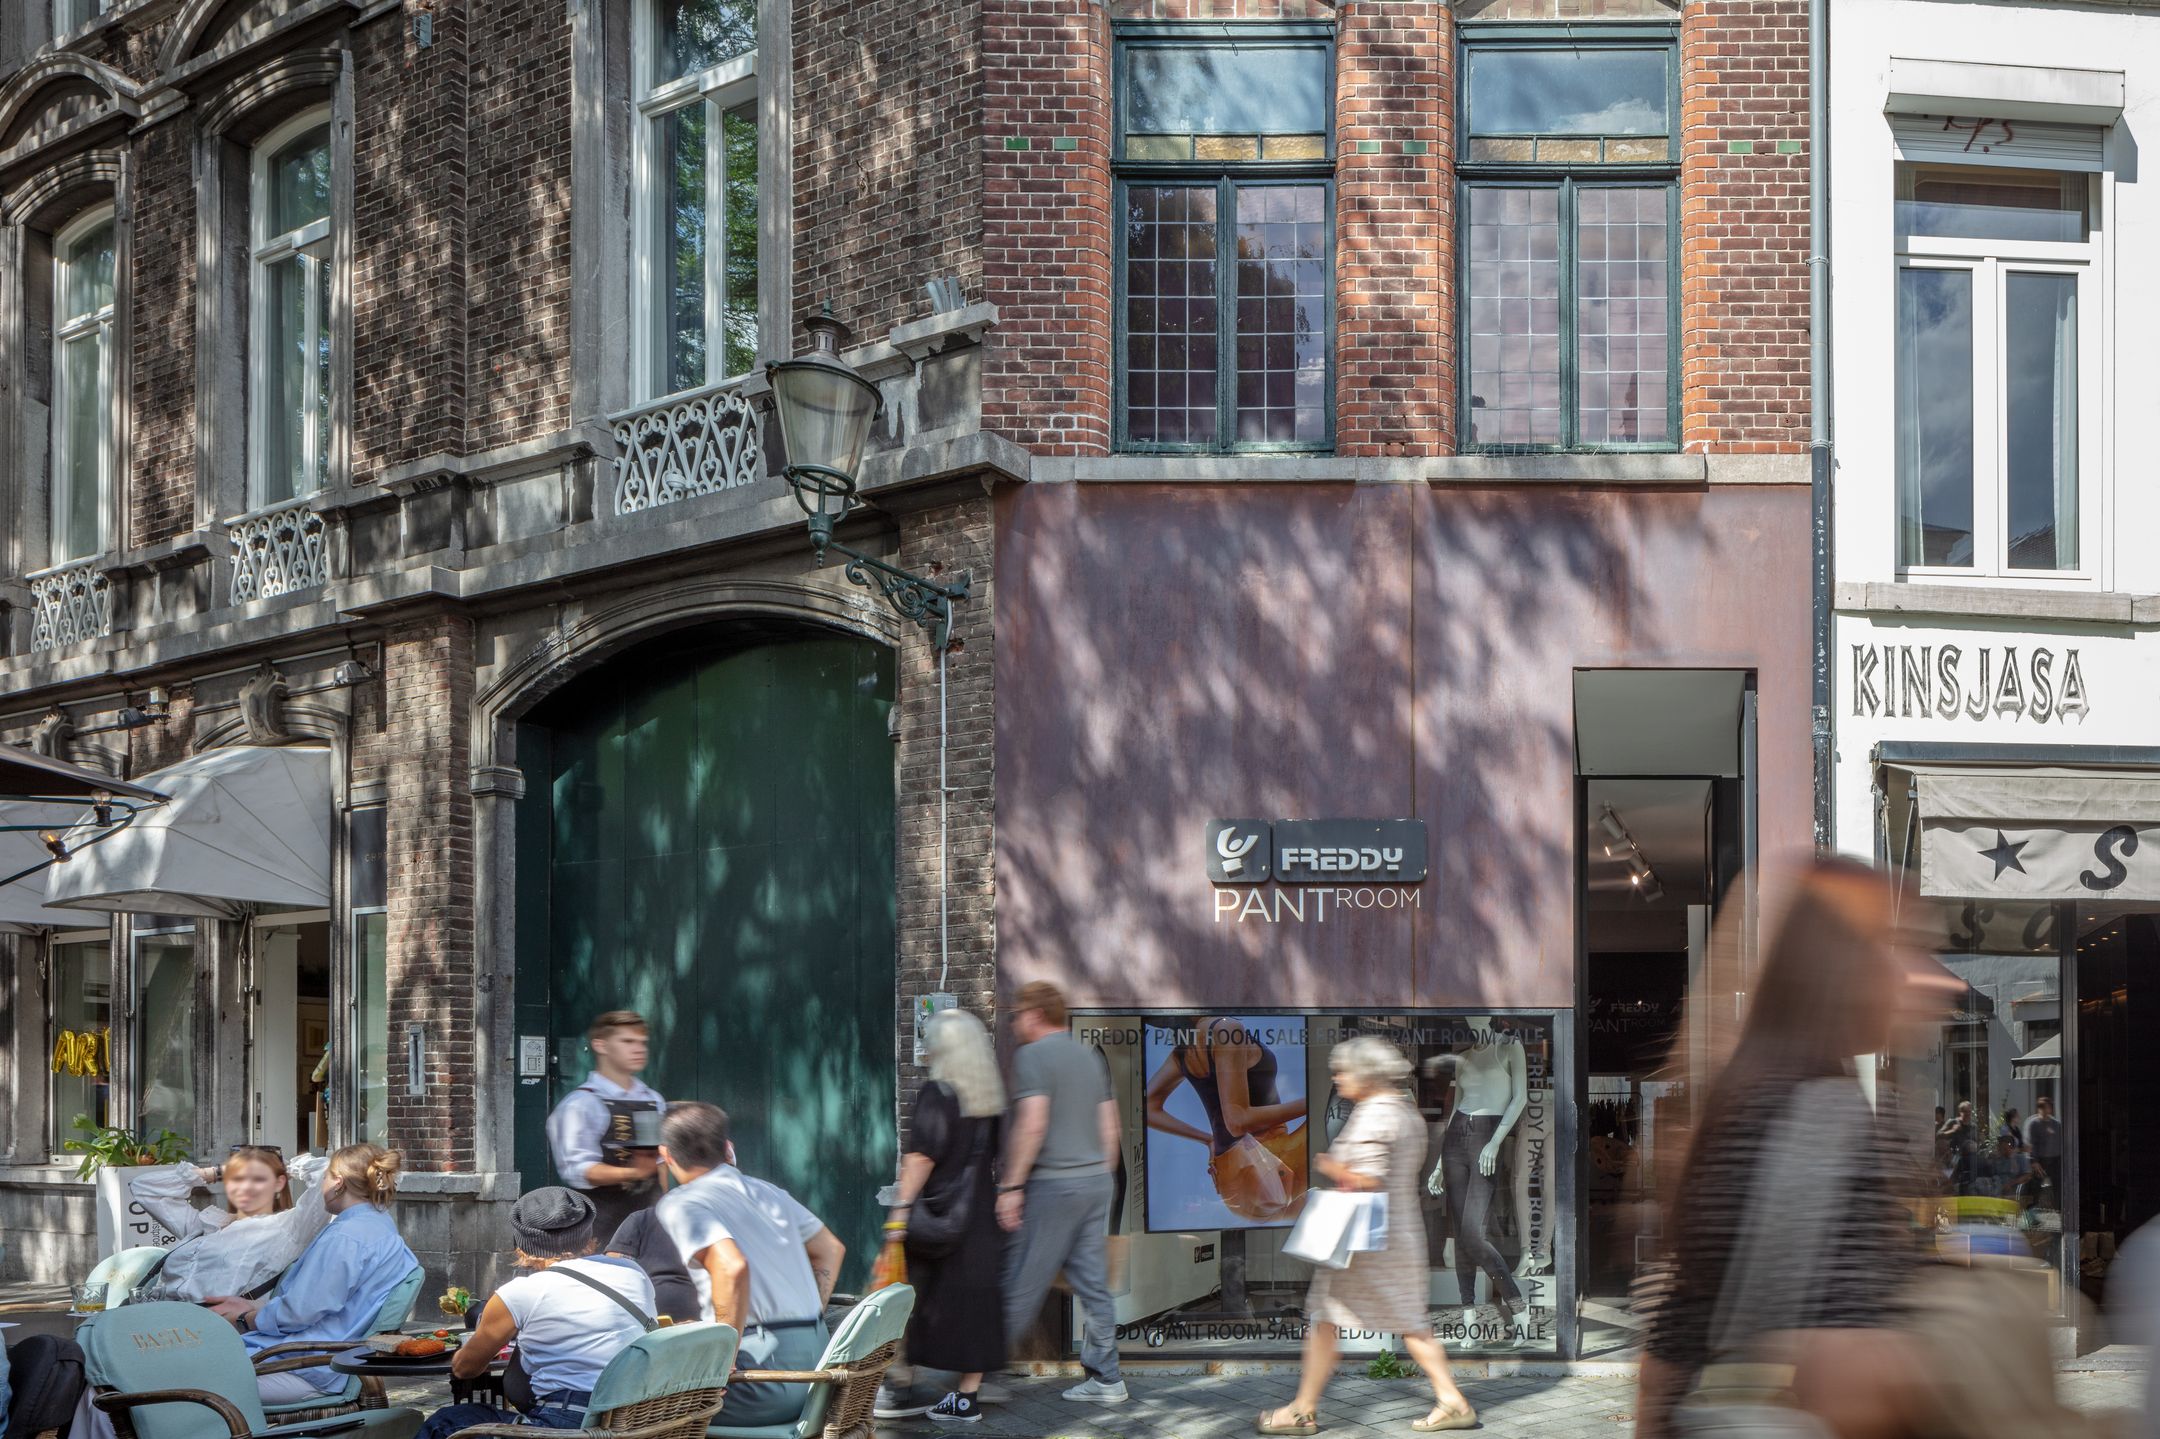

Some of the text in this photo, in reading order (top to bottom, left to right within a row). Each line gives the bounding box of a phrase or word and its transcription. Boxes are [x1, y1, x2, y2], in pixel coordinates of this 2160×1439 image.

[1851, 643, 2090, 726] KINSJASA
[1281, 847, 1403, 872] FREDDY
[1610, 1002, 1660, 1013] FREDDY
[1080, 1028, 1149, 1045] FREDDY
[1154, 1028, 1201, 1045] PANT
[1205, 1028, 1260, 1045] ROOM
[1266, 1028, 1308, 1045] SALE
[1442, 1028, 1496, 1046] ROOM
[1501, 1028, 1545, 1045] SALE
[1527, 1052, 1544, 1132] FREDDY
[128, 1200, 149, 1235] OP
[1528, 1196, 1545, 1261] ROOM
[1528, 1267, 1546, 1316] SALE
[1156, 1323, 1201, 1340] PANT
[1207, 1323, 1262, 1341] ROOM
[1267, 1323, 1310, 1341] SALE
[1442, 1323, 1497, 1340] ROOM
[1503, 1323, 1547, 1340] SALE
